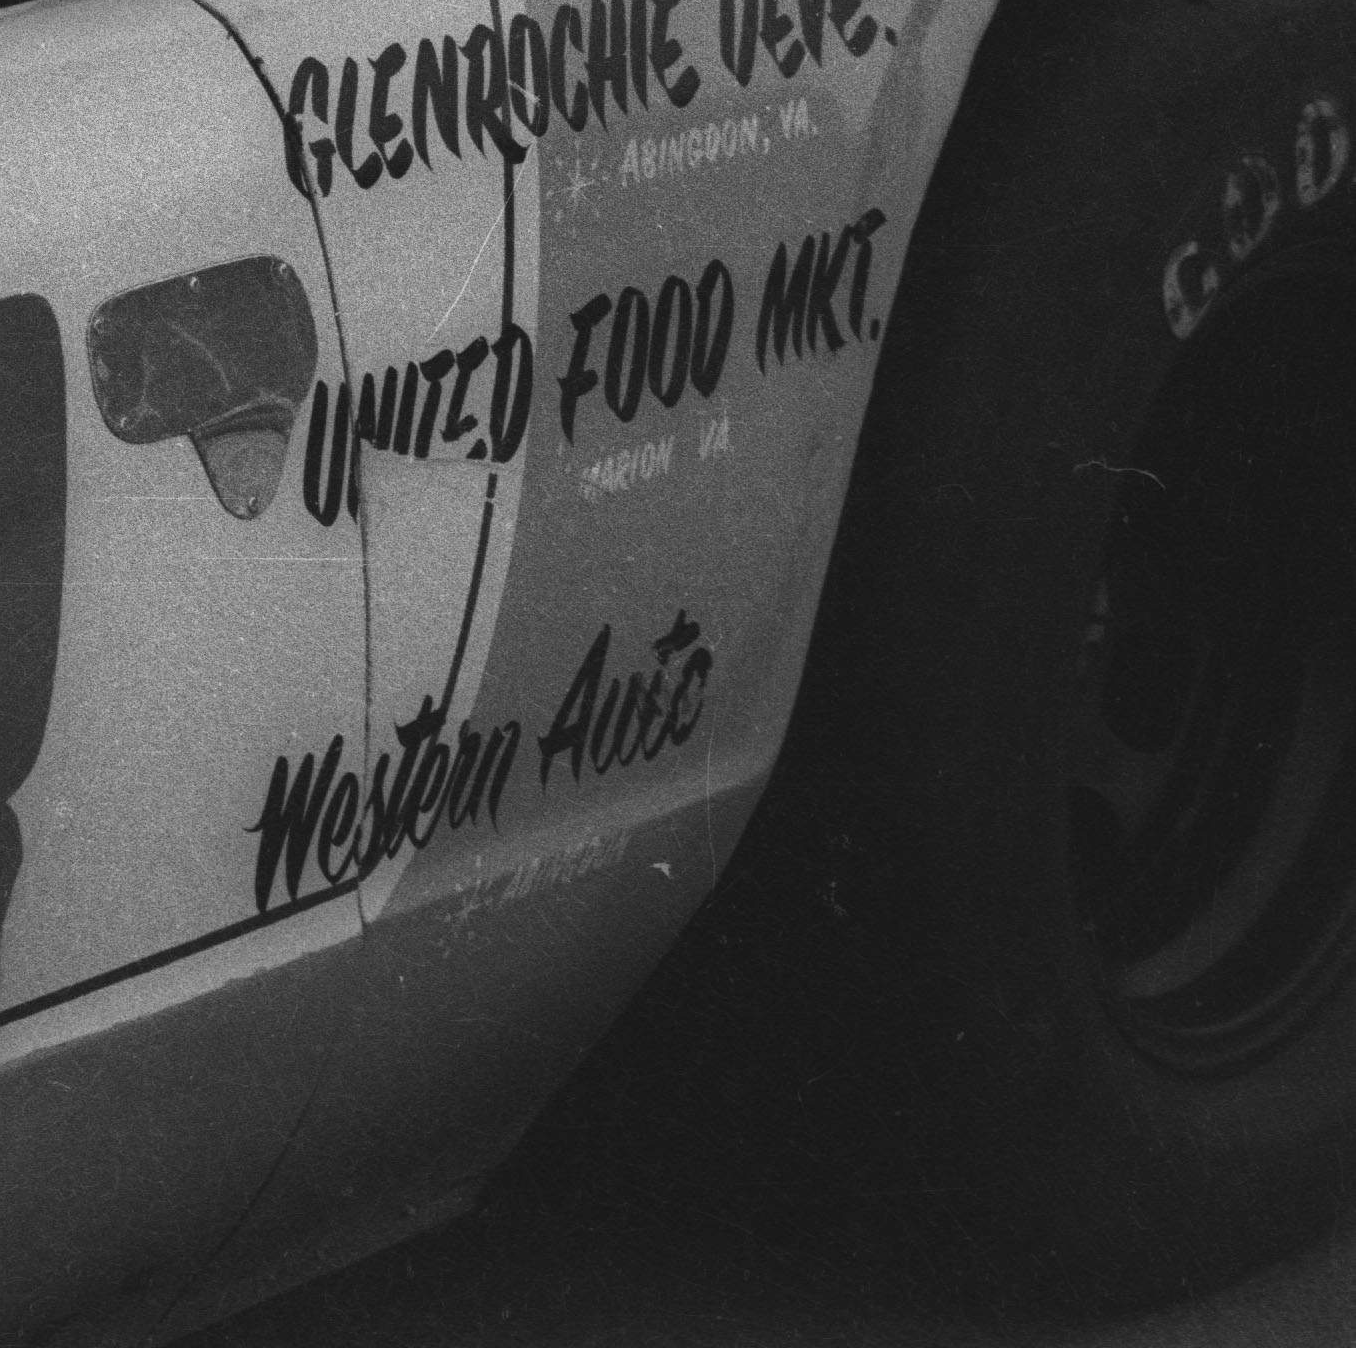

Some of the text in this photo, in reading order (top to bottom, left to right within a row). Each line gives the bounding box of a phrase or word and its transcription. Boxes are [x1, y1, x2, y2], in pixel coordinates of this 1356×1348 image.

[619, 114, 771, 189] ABINGDON,
[303, 207, 886, 527] UNITED FOOD MKT.
[244, 609, 714, 912] Western Auto
